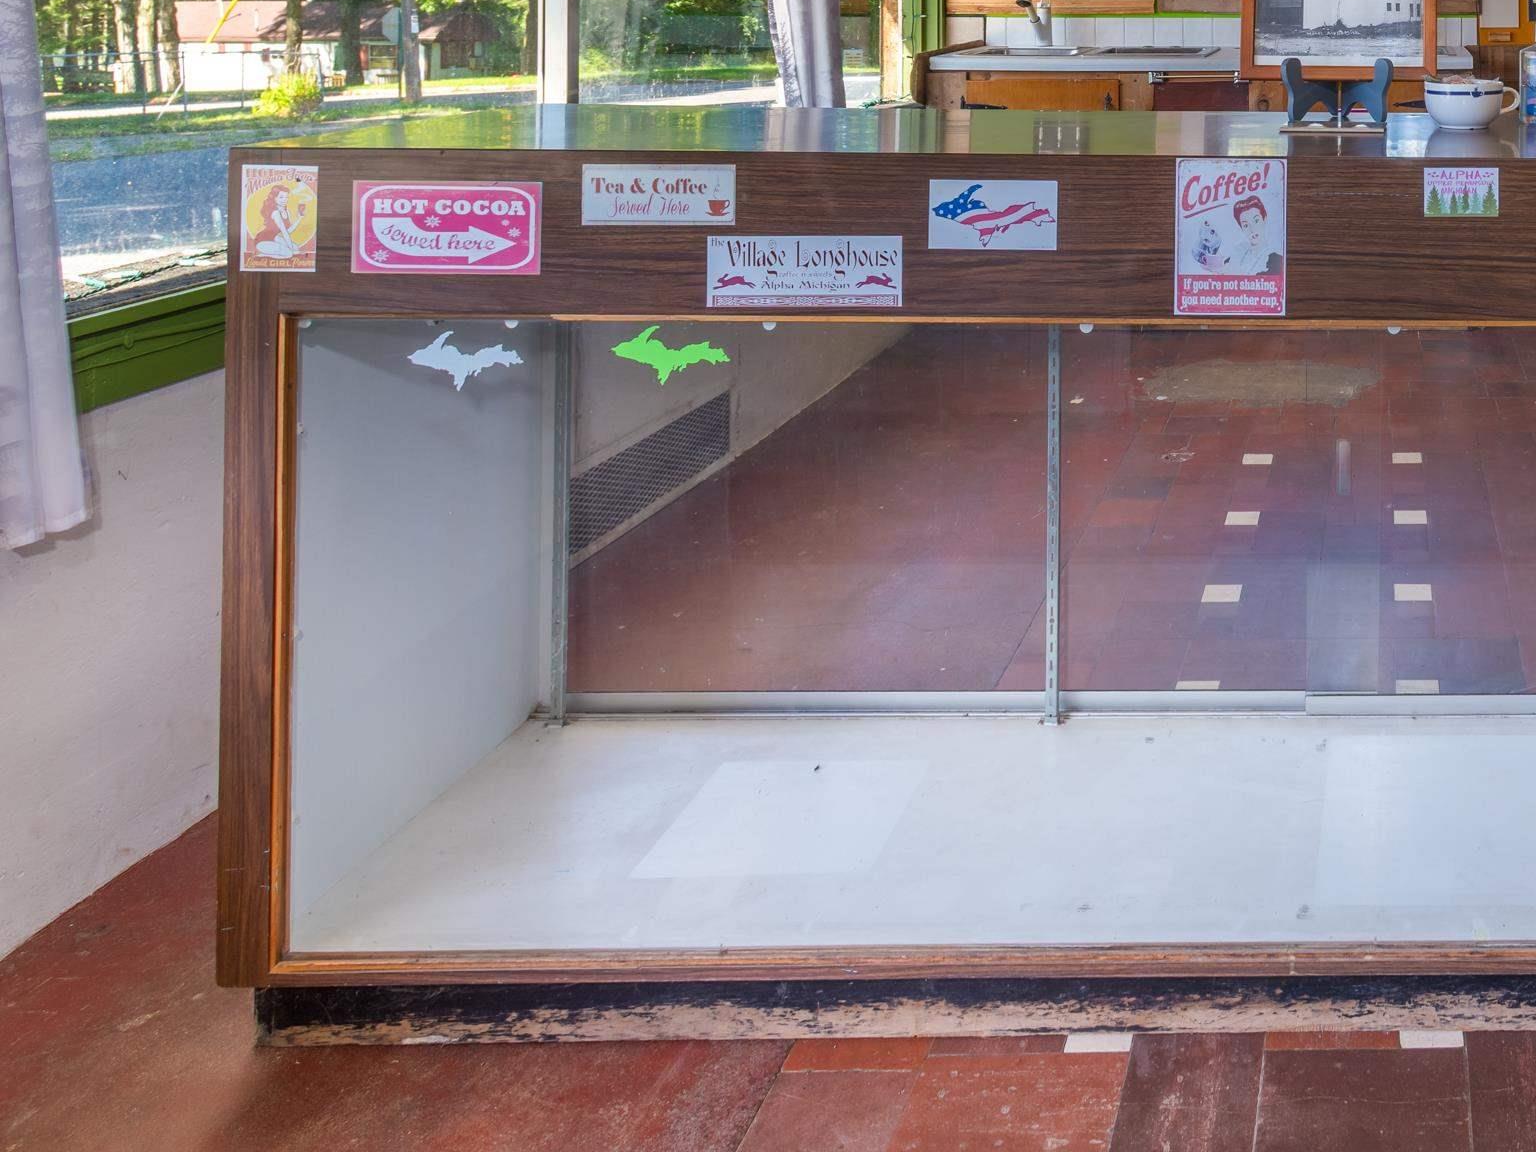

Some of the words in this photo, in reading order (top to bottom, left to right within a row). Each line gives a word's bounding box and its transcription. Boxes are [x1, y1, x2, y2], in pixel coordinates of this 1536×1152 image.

[1440, 169, 1482, 180] ALPHA
[591, 177, 625, 194] Tea
[630, 177, 646, 194] &
[652, 177, 708, 195] Coffee
[1181, 162, 1270, 212] Coffee!
[373, 199, 428, 214] HOT
[435, 200, 526, 216] COCOA
[608, 193, 654, 218] Served
[659, 196, 690, 216] Here
[380, 224, 442, 250] served
[448, 234, 496, 251] here
[269, 259, 292, 267] GIRL
[727, 239, 786, 280] Village
[794, 239, 898, 280] Longhouse
[761, 280, 795, 291] Alpha
[799, 280, 850, 292] Michigan
[1184, 278, 1193, 290] If
[1193, 278, 1221, 293] you're
[1224, 279, 1238, 290] not
[1182, 295, 1198, 308] you
[1200, 294, 1222, 305] need
[1224, 294, 1259, 306] another
[1261, 295, 1279, 308] cup.
